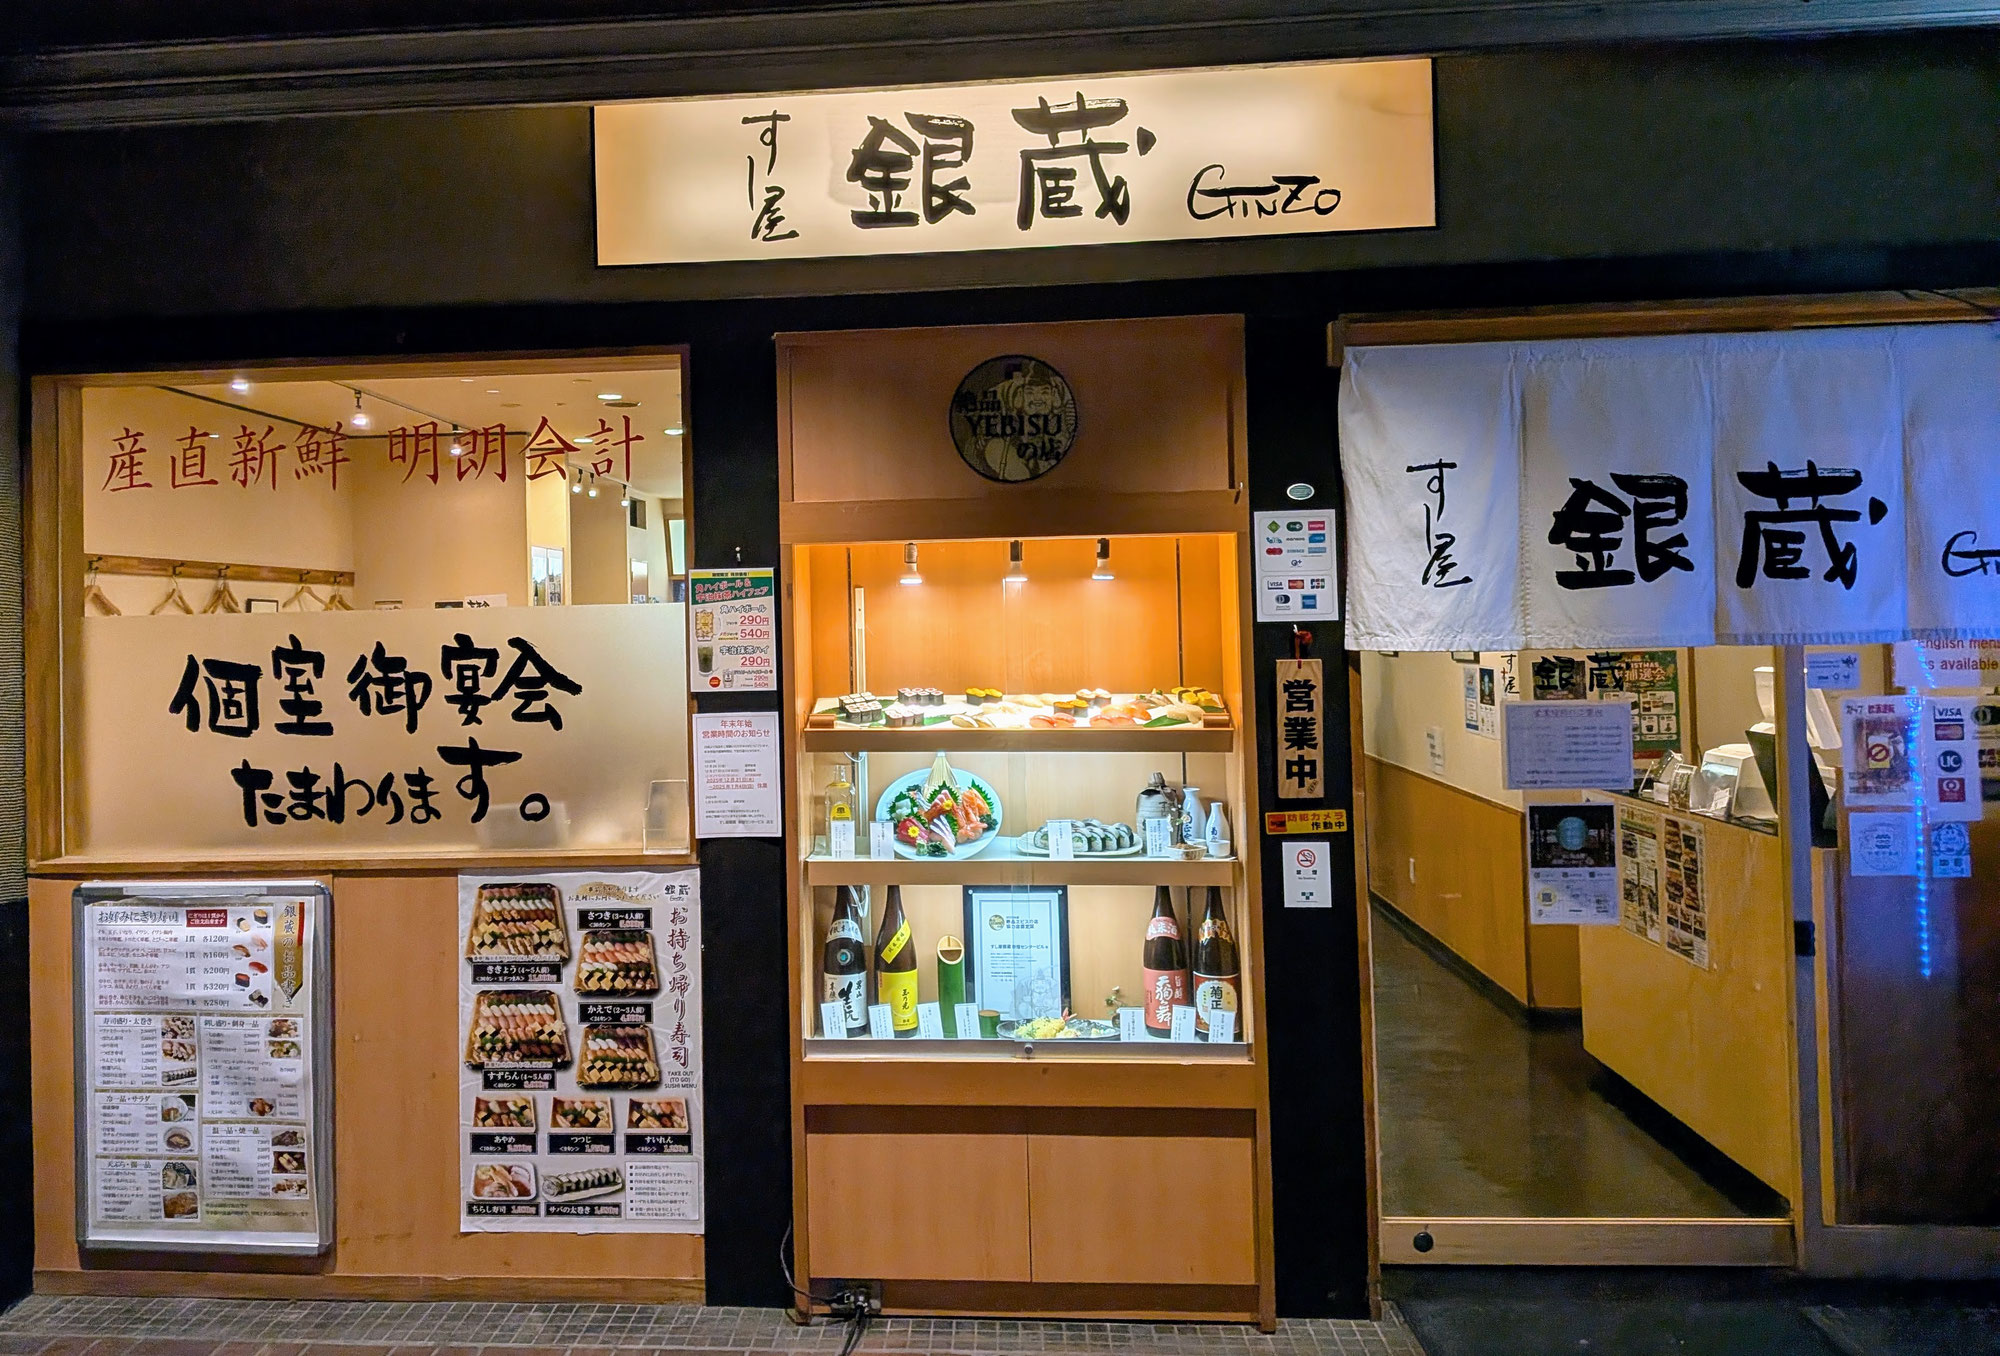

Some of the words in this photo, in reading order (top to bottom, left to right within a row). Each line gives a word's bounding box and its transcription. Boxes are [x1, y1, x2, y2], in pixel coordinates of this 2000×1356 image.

[847, 91, 1157, 232] 銀蔵
[741, 109, 800, 245] すし屋
[1187, 163, 1343, 221] GINZO
[965, 413, 1062, 436] YEBISU
[102, 421, 351, 492] 産直新鮮
[387, 414, 645, 485] 明朗会計
[1406, 458, 1473, 587] すし屋
[1547, 460, 1888, 591] 銀蔵
[720, 605, 767, 614] 角ハイボール
[740, 615, 769, 625] 290円
[740, 628, 769, 638] 540円
[720, 645, 769, 655] 宇治抹茶ハイ
[741, 656, 770, 666] 290円
[1940, 657, 1999, 670] available
[168, 633, 582, 737] 個室御宴会
[1937, 708, 1963, 716] VISA
[720, 720, 752, 728] 年末年始
[702, 730, 770, 739] 営業時間のお知らせ
[1283, 679, 1318, 788] 営業中
[1940, 755, 1961, 768] UC
[230, 736, 551, 829] たまわります。
[1287, 811, 1344, 822] 防犯カメラ
[1311, 821, 1345, 830] 作動中
[98, 911, 179, 923] お好みにぎり寿司
[202, 951, 229, 959] 各160円
[282, 905, 297, 1005] 銀蔵のお品書き
[203, 983, 230, 991] 各320円
[666, 906, 690, 1069] お持ち帰り寿司
[104, 1018, 153, 1026] 寿司盛り・太巻き
[494, 1136, 515, 1144] あやめ
[571, 1136, 592, 1144] つつじ
[644, 1136, 674, 1144] すいれん
[472, 1205, 507, 1214] ちらし寿司
[549, 1206, 591, 1214] サバの太巻き
